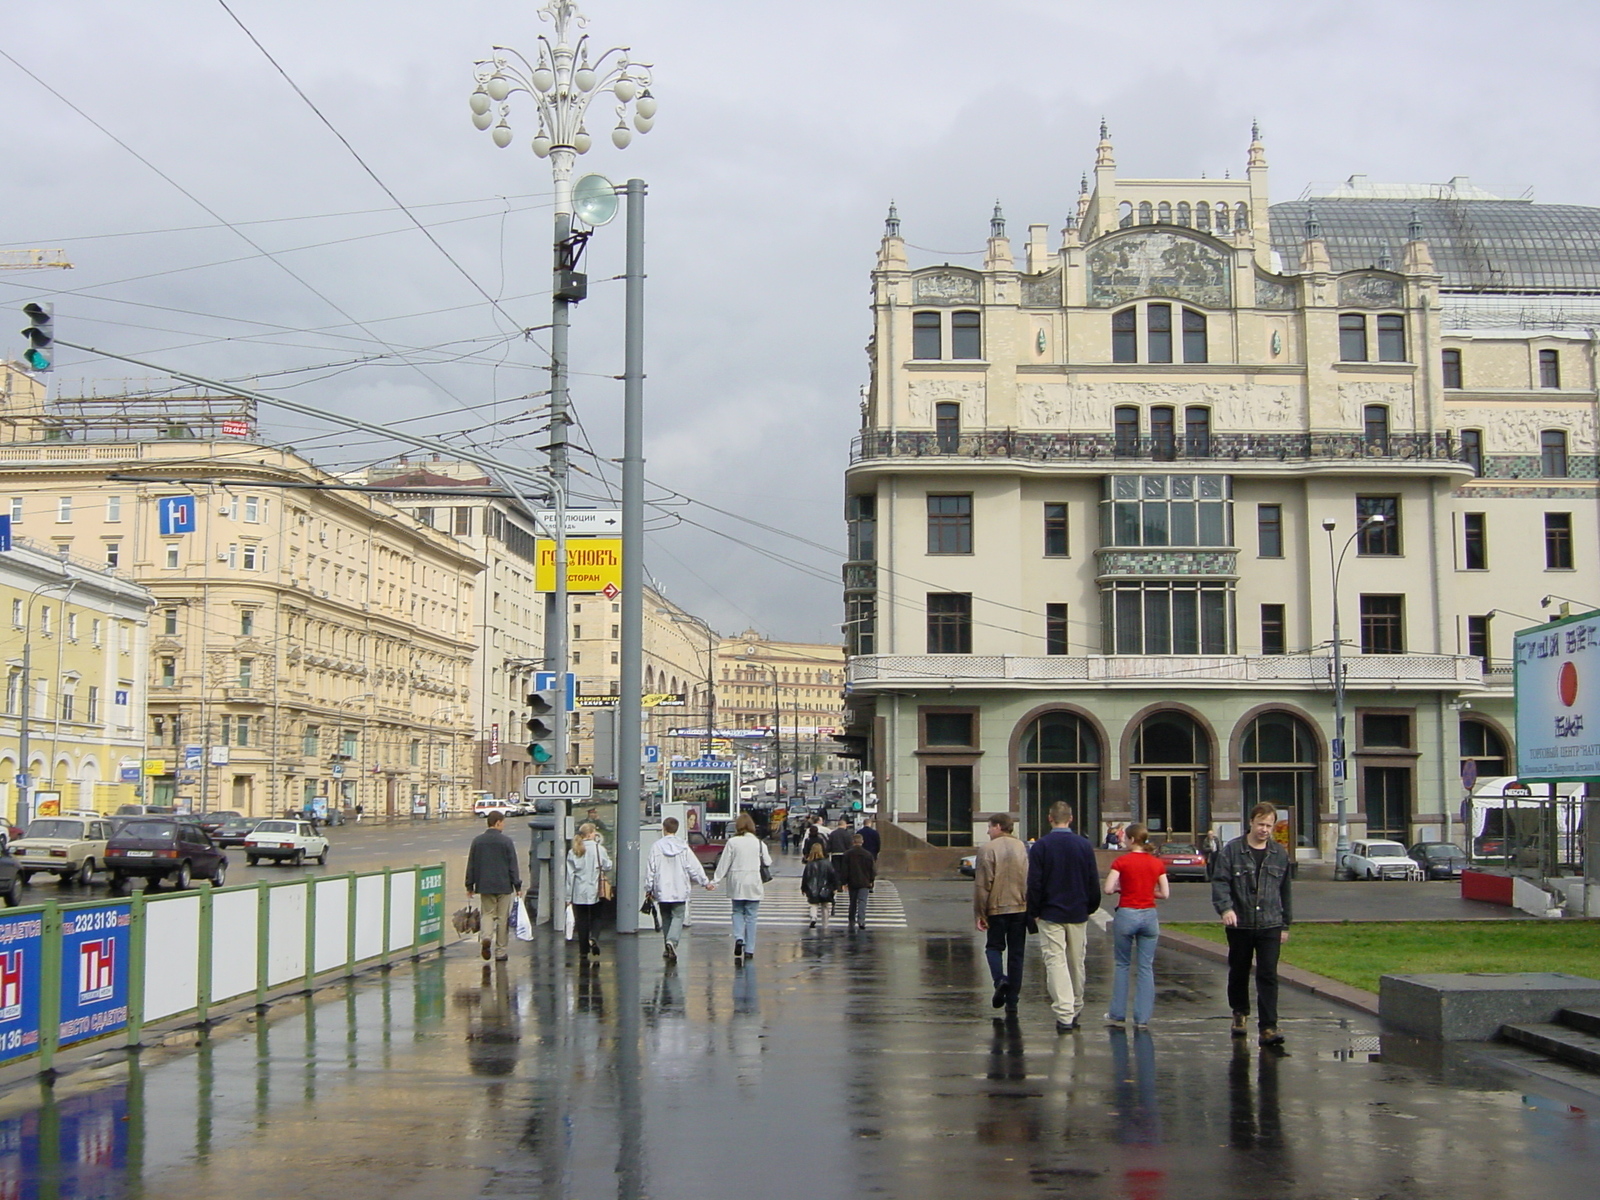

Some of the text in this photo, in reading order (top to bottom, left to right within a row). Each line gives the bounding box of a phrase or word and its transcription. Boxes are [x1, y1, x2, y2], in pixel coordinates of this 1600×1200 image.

[543, 514, 596, 522] РЕЛЮЦИИ
[541, 549, 617, 567] ГОУНОВЪ
[565, 574, 600, 582] СТОРАН
[1565, 624, 1600, 654] ВЕС
[537, 780, 580, 794] СТОП
[75, 914, 93, 933] 232
[94, 912, 105, 930] 31
[105, 910, 118, 928] 36
[91, 1006, 128, 1032] СДАЕТСЯ
